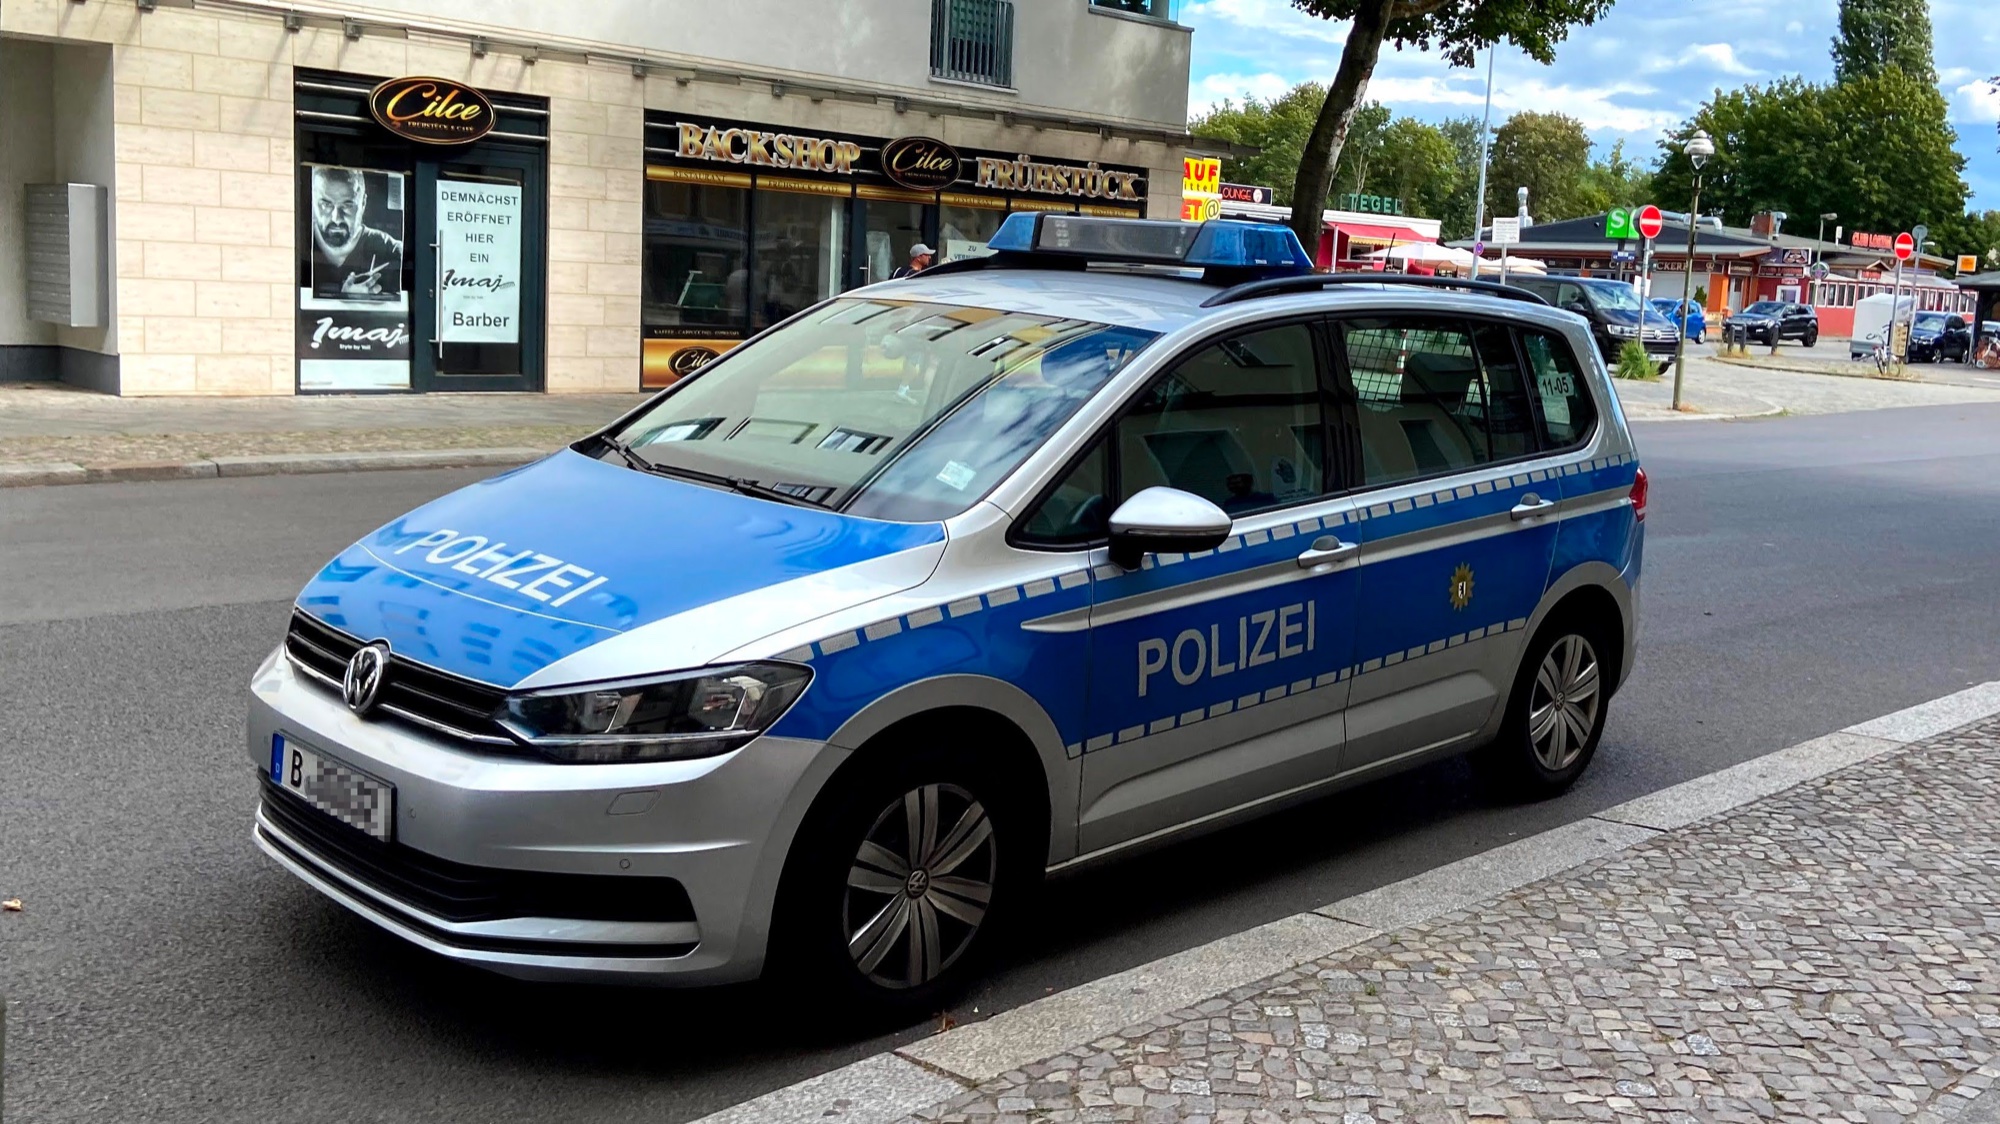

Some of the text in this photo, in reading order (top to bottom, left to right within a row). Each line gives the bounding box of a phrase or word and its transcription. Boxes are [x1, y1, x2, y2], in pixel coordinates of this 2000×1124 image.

[675, 122, 861, 174] BACKSHOP
[673, 170, 726, 183] RESTAURANT
[975, 153, 1139, 201] FRÜHSTÜCK
[441, 190, 519, 206] DEMNÄCHST
[1349, 193, 1404, 214] TEGEL
[447, 211, 512, 225] ERÖFFNET
[1610, 211, 1625, 228] S
[465, 232, 494, 244] HIER
[469, 252, 489, 263] EIN
[453, 312, 509, 327] Barber
[1543, 377, 1568, 396] 11-05
[395, 529, 608, 608] POLIZEI
[1138, 600, 1315, 697] POLIZEI
